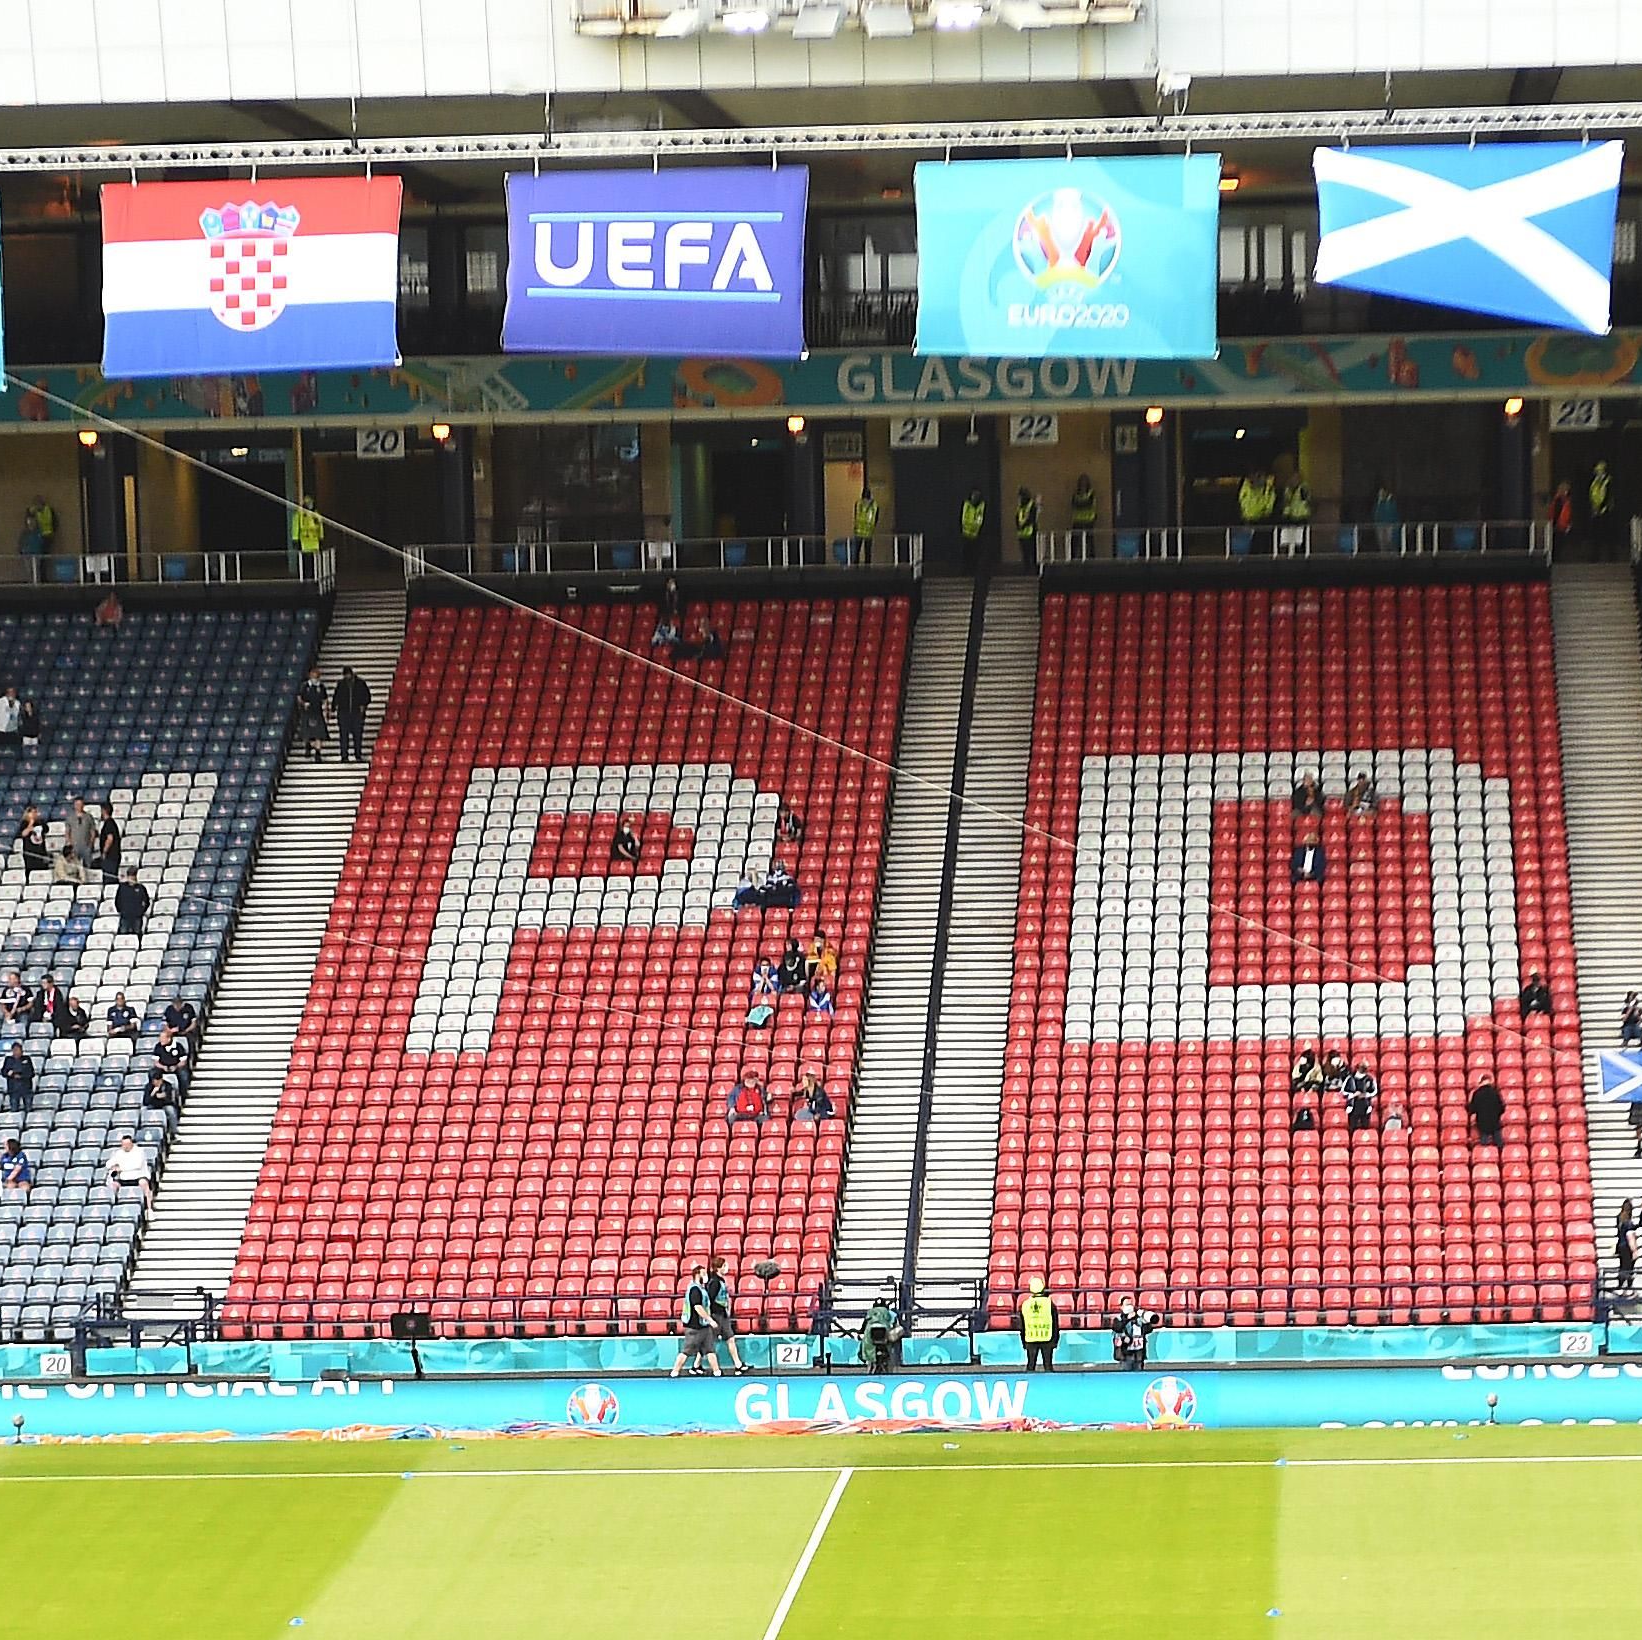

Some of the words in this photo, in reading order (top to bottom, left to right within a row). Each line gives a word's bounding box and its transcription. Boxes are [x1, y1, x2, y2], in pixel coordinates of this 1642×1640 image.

[534, 221, 774, 291] UEFA
[836, 355, 1137, 401] GLASGOW
[899, 418, 929, 442] 21
[1016, 415, 1053, 440] 22
[363, 430, 398, 453] 20
[782, 1346, 802, 1362] 21
[1566, 1336, 1587, 1351] 23
[45, 1357, 66, 1372] 20
[735, 1380, 1029, 1427] GLASGOW
